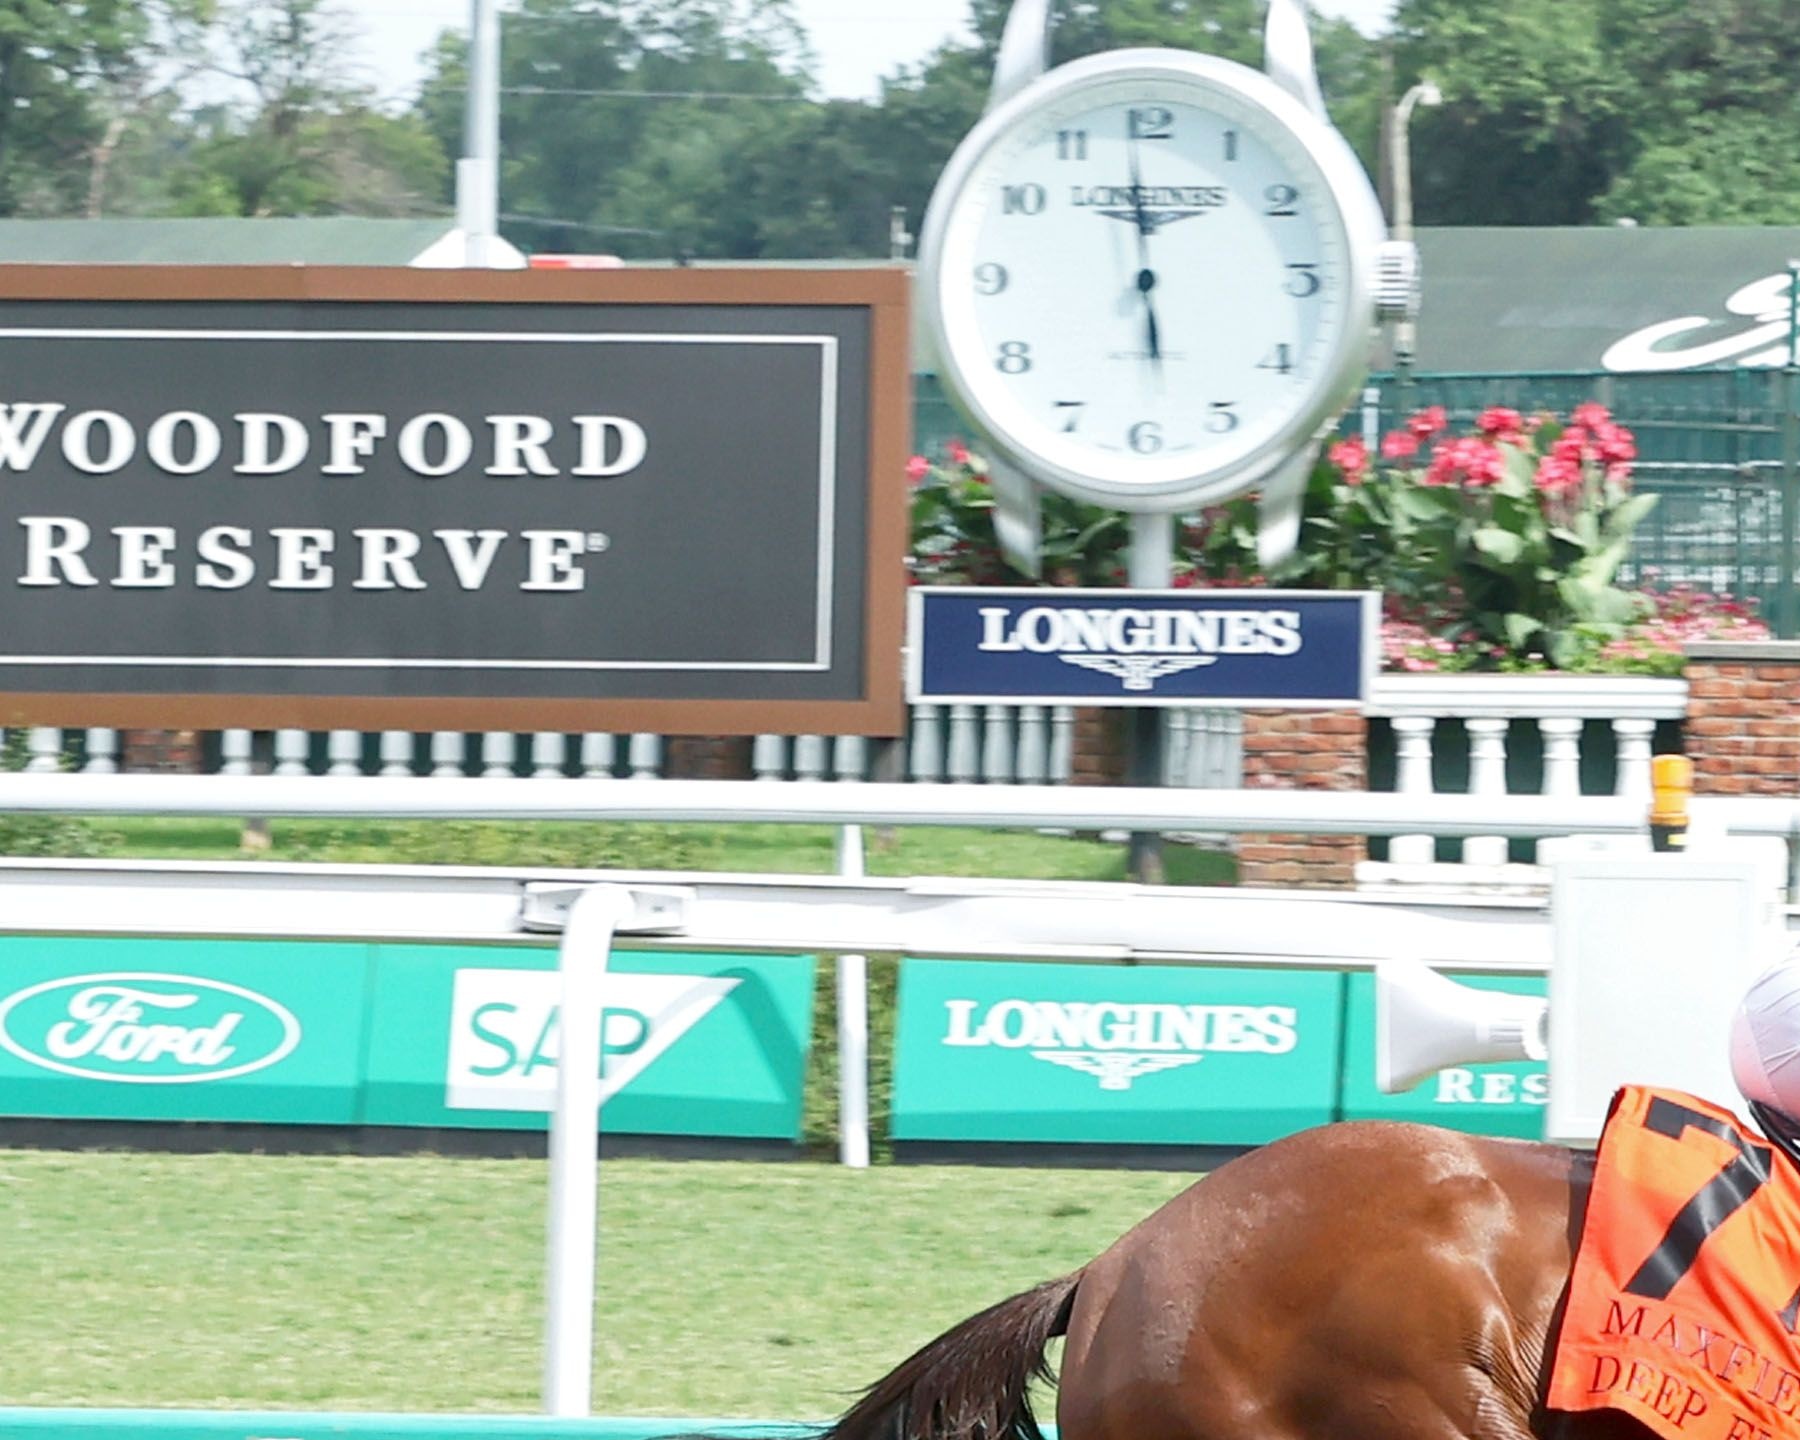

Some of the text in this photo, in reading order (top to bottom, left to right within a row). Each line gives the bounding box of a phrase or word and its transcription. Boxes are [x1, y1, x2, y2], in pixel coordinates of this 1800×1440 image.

[1127, 107, 1174, 139] 12
[1057, 130, 1088, 160] 11
[1223, 130, 1238, 161] 1
[1001, 183, 1045, 215] 10
[1070, 185, 1227, 207] LONGINES
[1263, 185, 1298, 216] 2
[973, 262, 1008, 297] 9
[996, 341, 1032, 374] 8
[1255, 343, 1296, 375] 4
[1053, 401, 1087, 432] 7
[1205, 401, 1239, 434] 5
[0, 402, 647, 476] WOODFORD
[1128, 421, 1162, 454] 6
[978, 606, 1302, 655] LONGINES
[46, 985, 243, 1066] Ford
[943, 999, 1296, 1054] LONGINES
[1622, 1095, 1772, 1301] 7
[1586, 1355, 1707, 1430] DEEP
